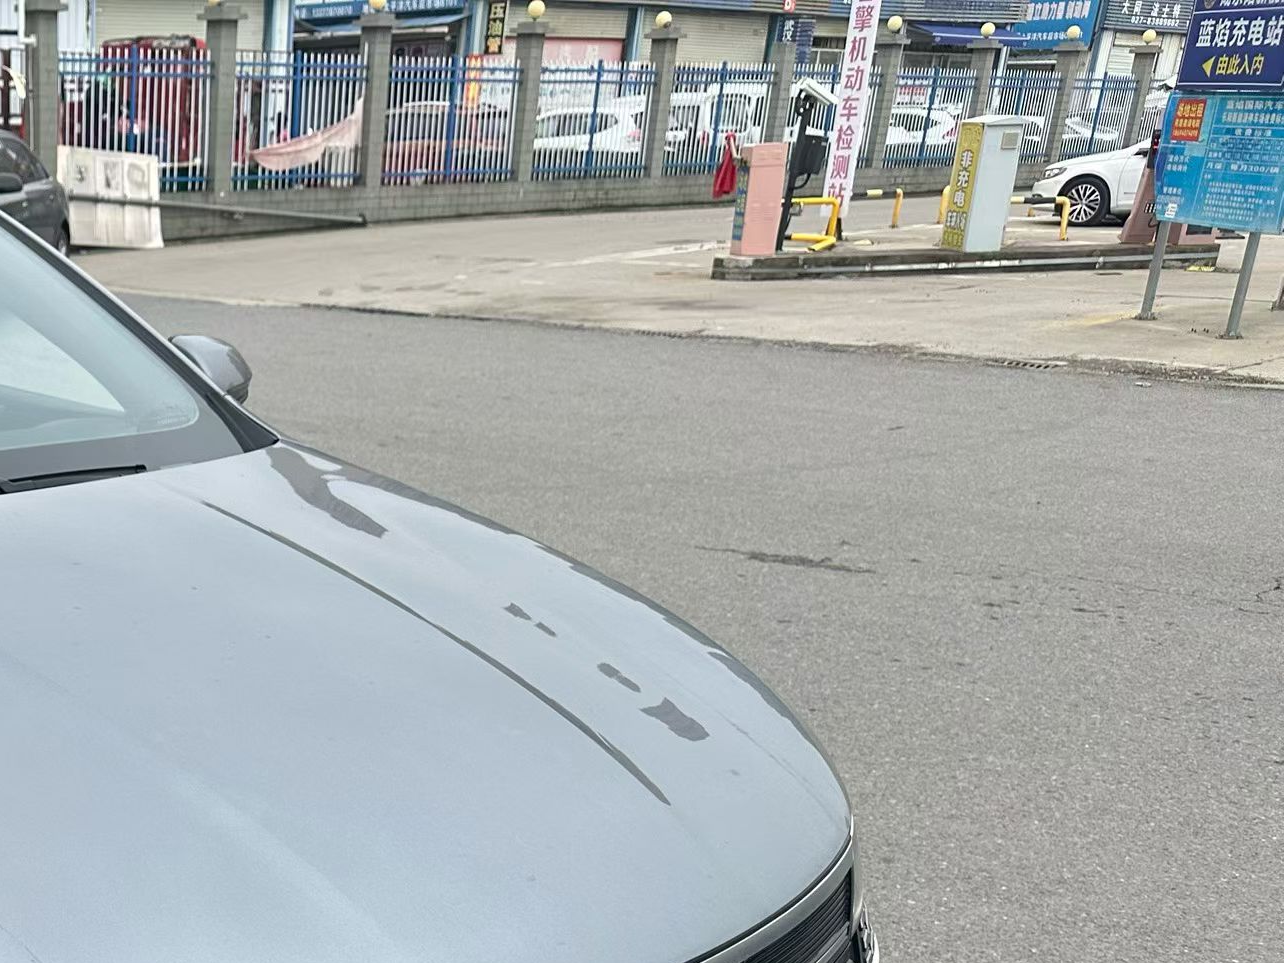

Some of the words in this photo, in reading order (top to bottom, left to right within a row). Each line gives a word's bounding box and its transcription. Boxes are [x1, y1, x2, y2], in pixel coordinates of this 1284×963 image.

[1196, 15, 1284, 47] 蓝焰充电站
[1216, 53, 1265, 75] 由此入内
[827, 0, 874, 208] 擎机动车检测站
